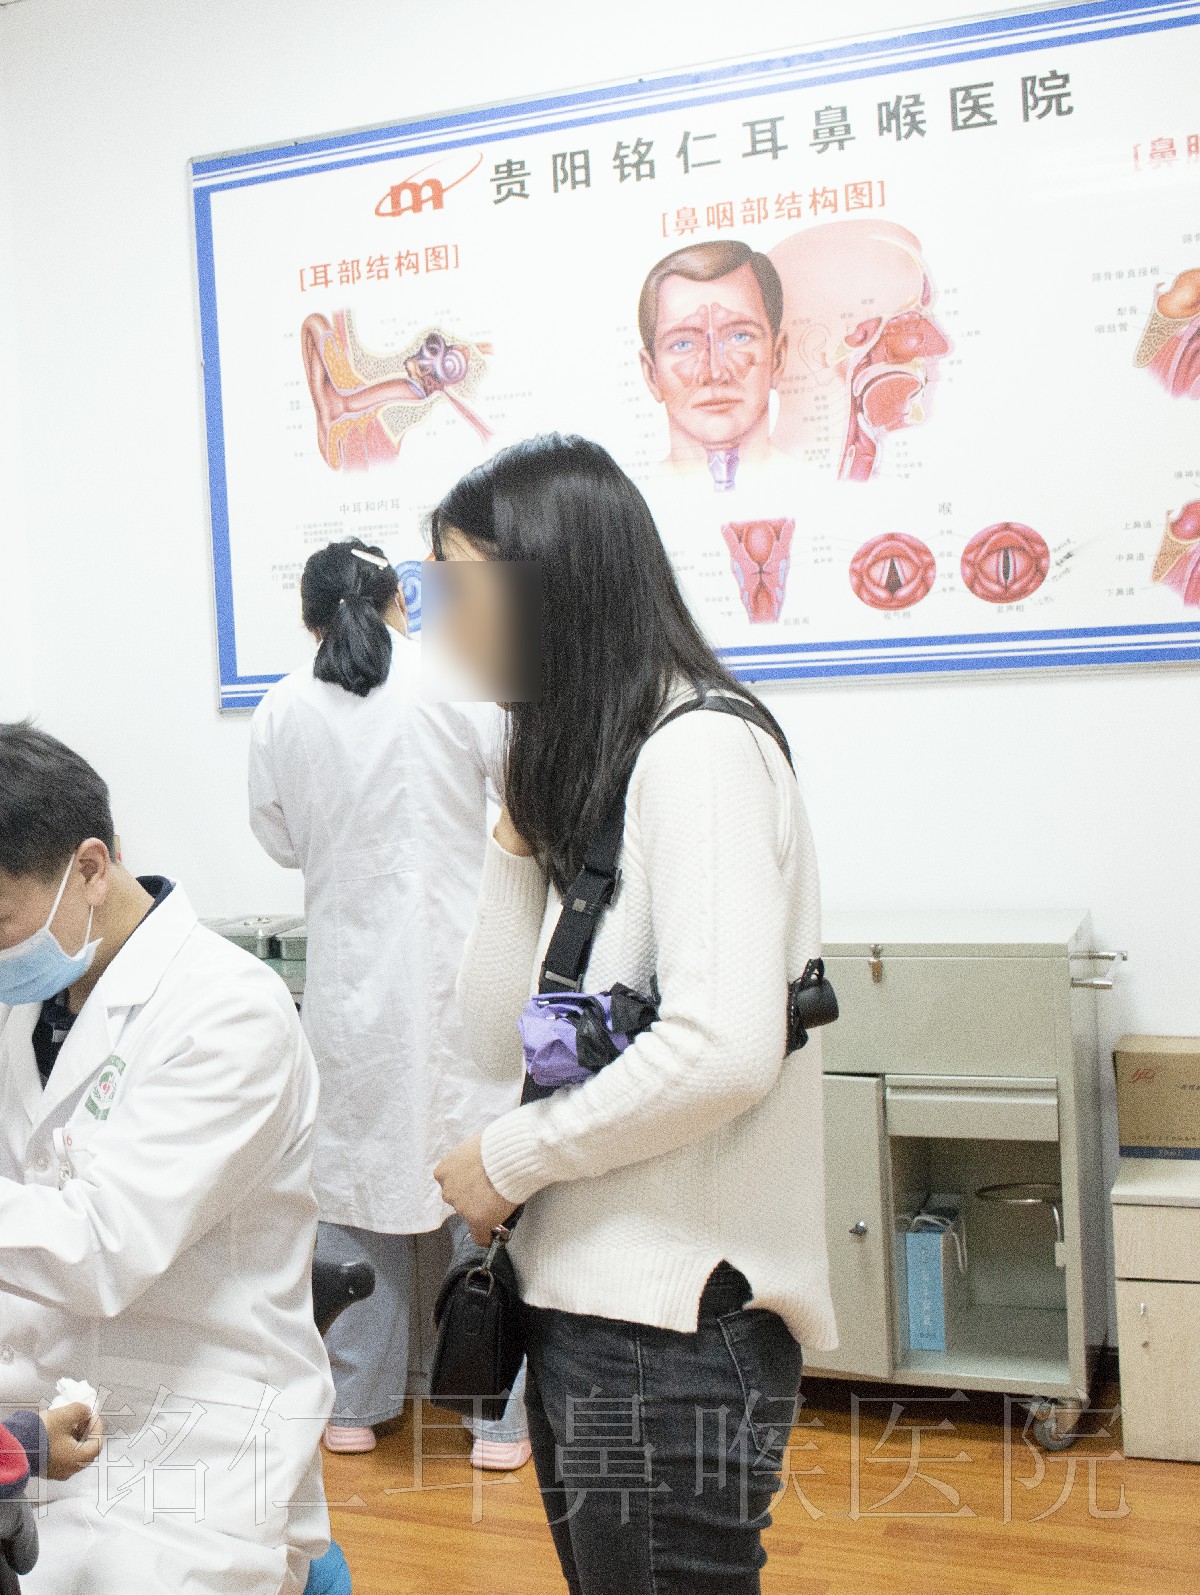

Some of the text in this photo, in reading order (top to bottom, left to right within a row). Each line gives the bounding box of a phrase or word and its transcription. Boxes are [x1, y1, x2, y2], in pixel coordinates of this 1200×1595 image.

[488, 69, 1075, 205] 贵阳铭仁耳鼻喉医院
[661, 180, 887, 239] [鼻咽部结构图]
[299, 243, 461, 292] [耳部结构图]
[338, 497, 401, 516] 中耳和内耳
[938, 501, 953, 516] 喉
[1124, 521, 1152, 530] 上鼻道
[1116, 553, 1145, 561] 中鼻道
[1107, 587, 1135, 596] 下鼻道
